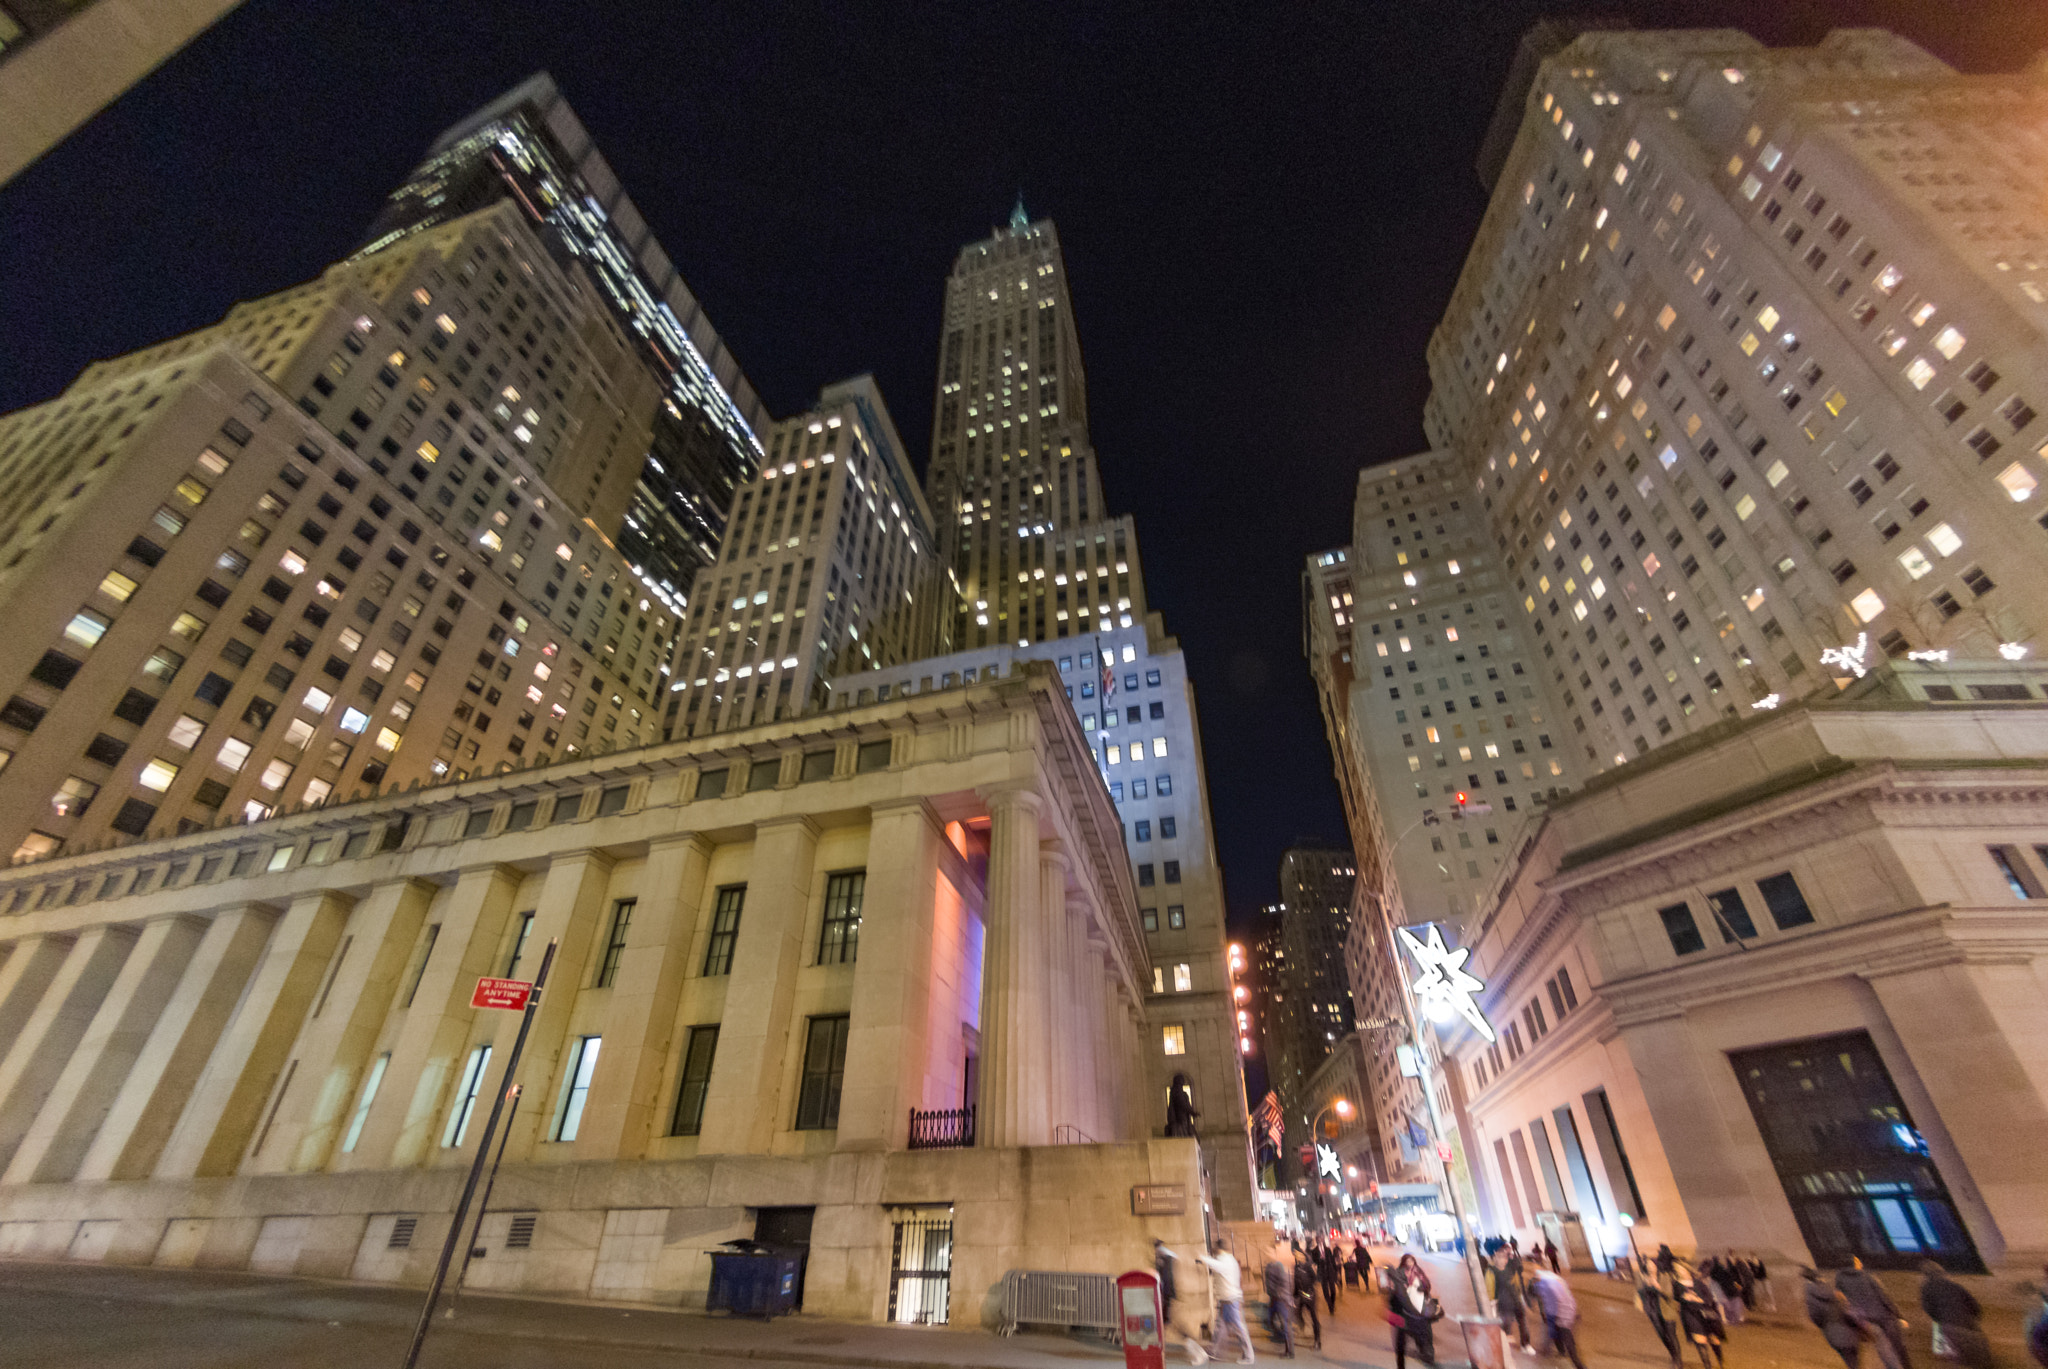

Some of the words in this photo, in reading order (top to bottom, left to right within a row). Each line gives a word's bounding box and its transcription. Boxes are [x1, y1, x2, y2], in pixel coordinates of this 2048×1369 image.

[480, 980, 492, 988] NO
[494, 981, 530, 991] STANDING
[483, 989, 521, 999] ANYTIME
[1355, 1017, 1385, 1030] NASSAU
